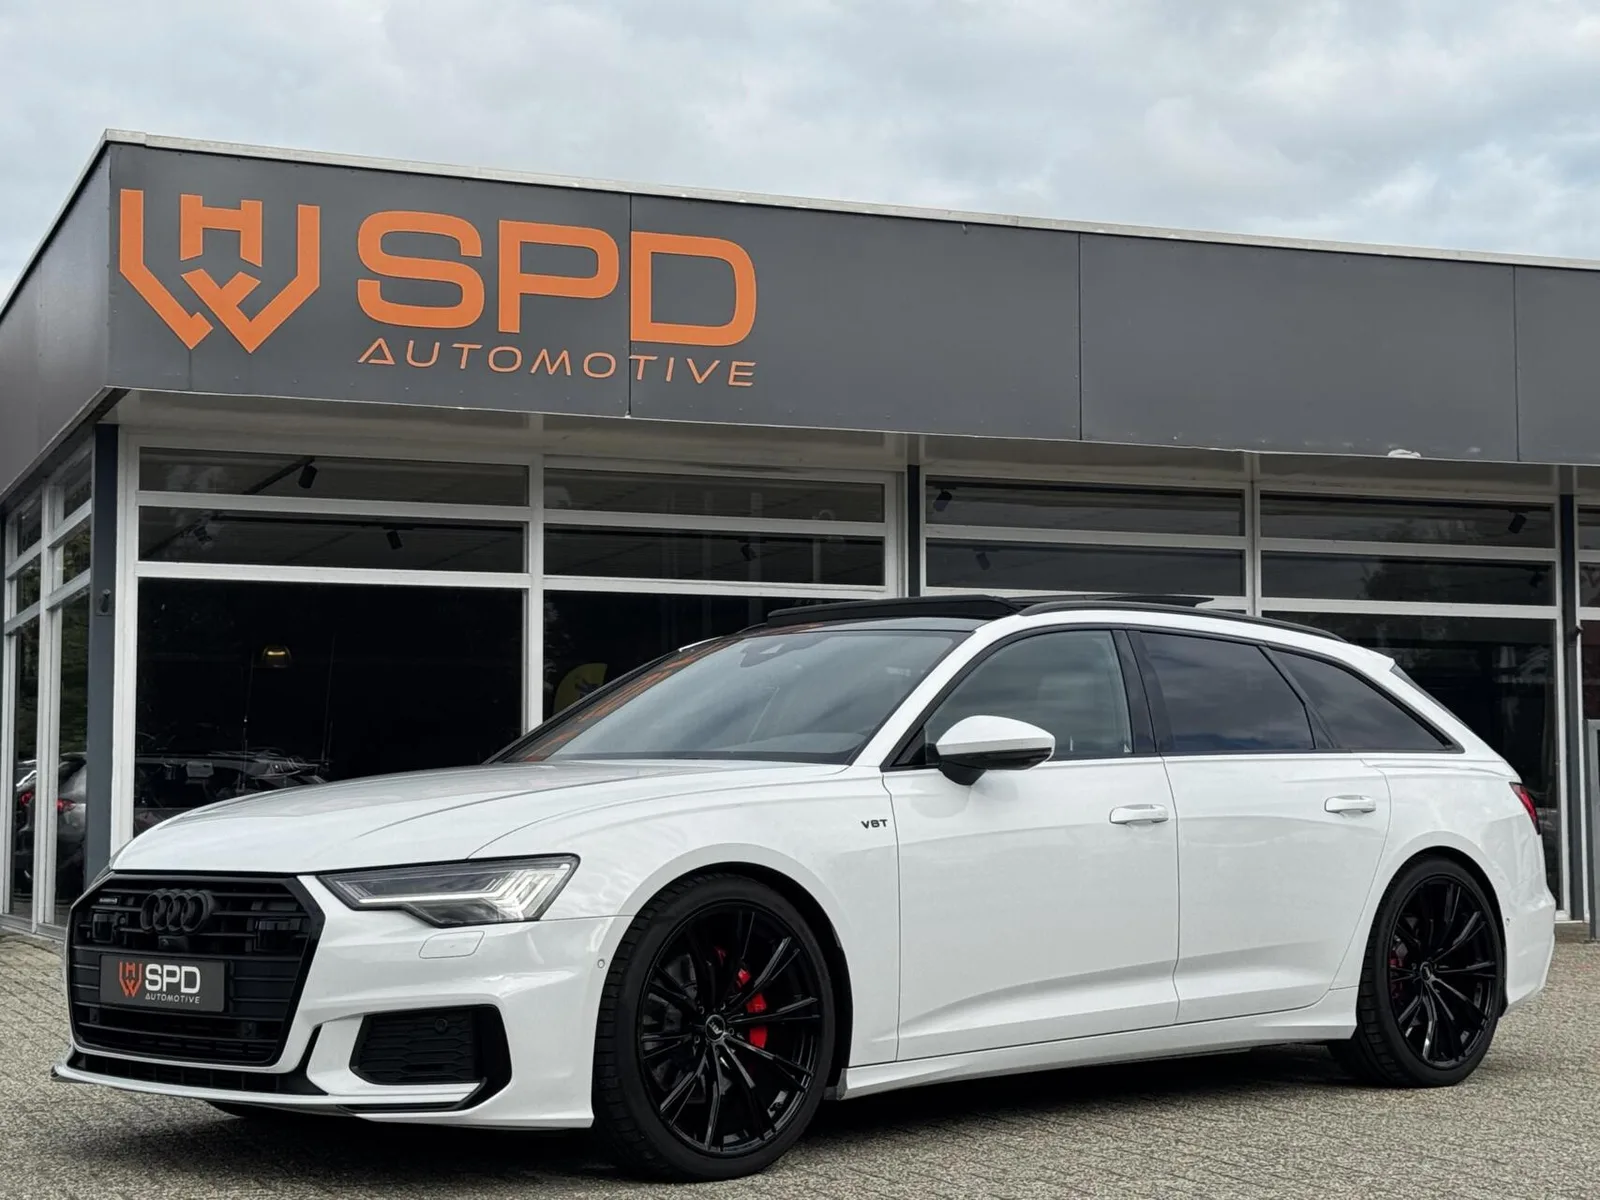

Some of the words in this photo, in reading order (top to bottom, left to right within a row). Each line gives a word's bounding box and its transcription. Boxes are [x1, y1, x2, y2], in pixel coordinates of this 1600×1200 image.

[356, 209, 757, 347] SPD
[357, 336, 757, 387] AUTOMOTIVE
[145, 963, 201, 994] SPD
[145, 993, 200, 1004] AUTOMOTIVE
